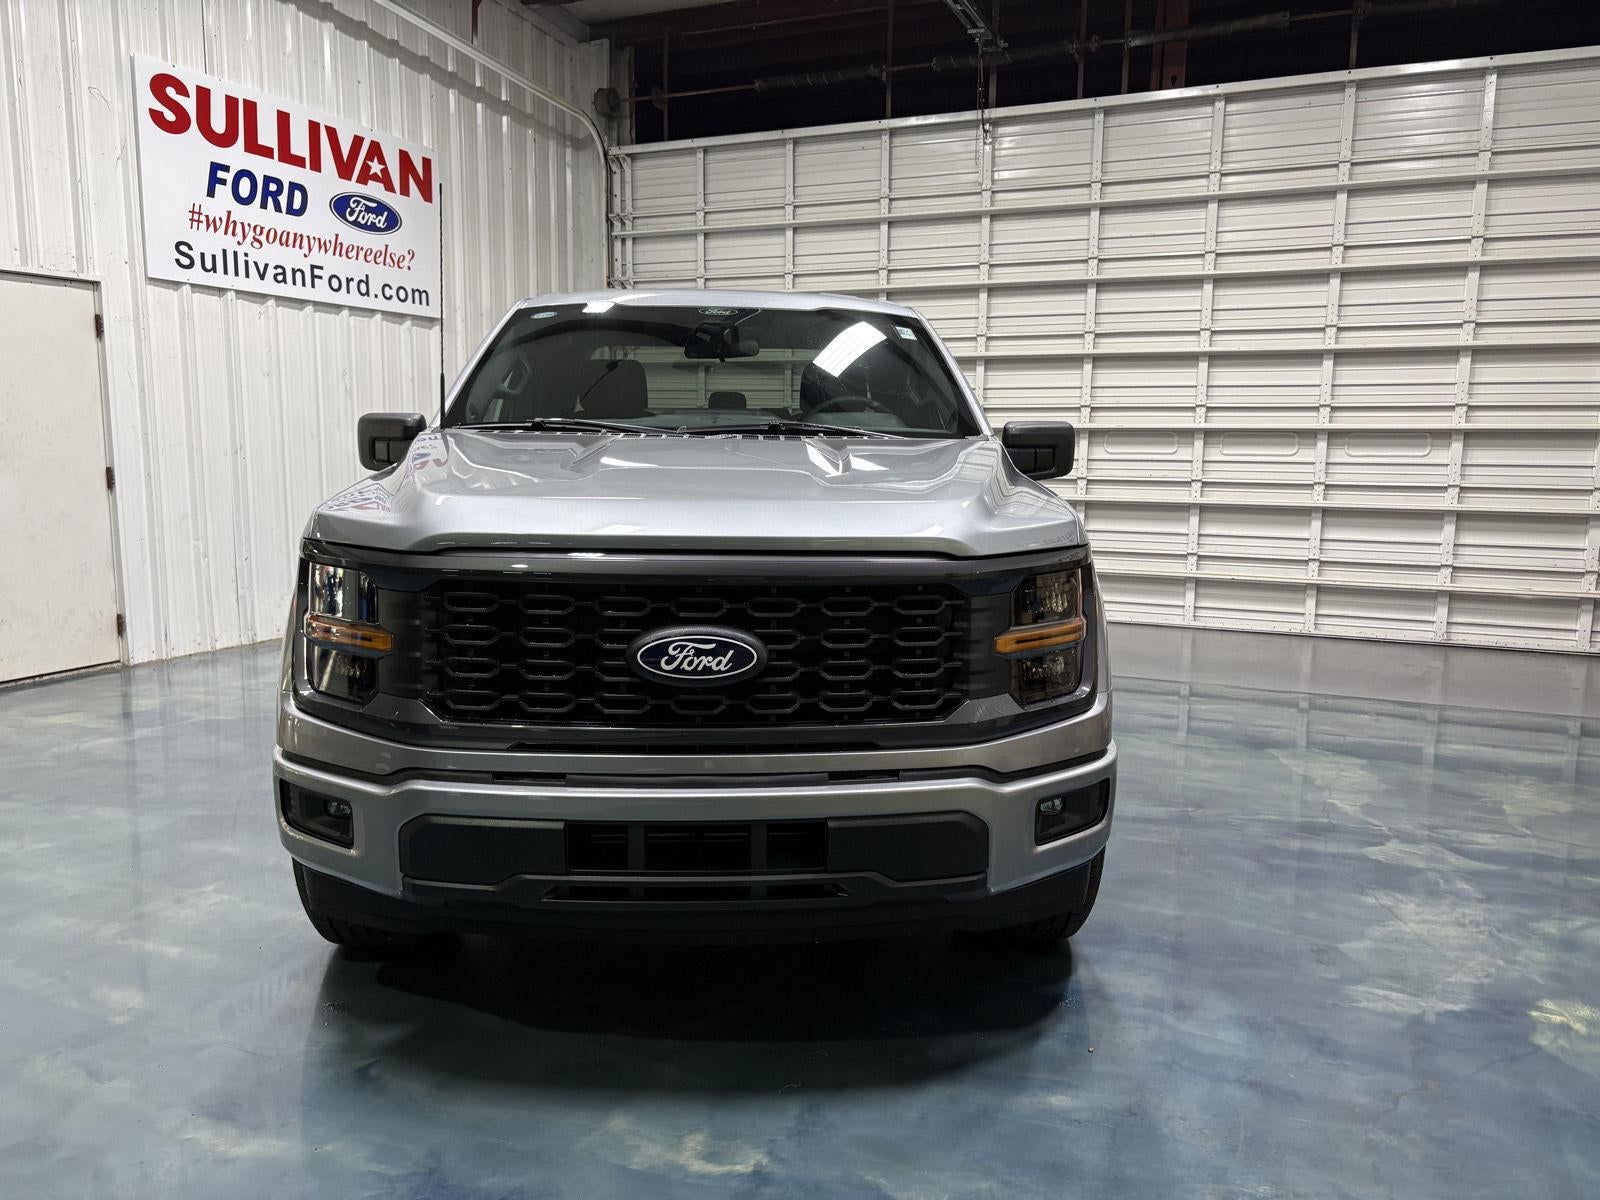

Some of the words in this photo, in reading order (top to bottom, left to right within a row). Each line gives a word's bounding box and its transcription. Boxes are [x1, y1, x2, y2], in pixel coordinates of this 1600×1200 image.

[148, 73, 433, 203] SULLIVAN
[206, 161, 309, 217] FORD
[345, 196, 388, 229] Ford
[188, 203, 416, 271] #whygoanywhereelse?
[174, 240, 431, 307] SullivanFord.com
[660, 641, 734, 671] Ford
